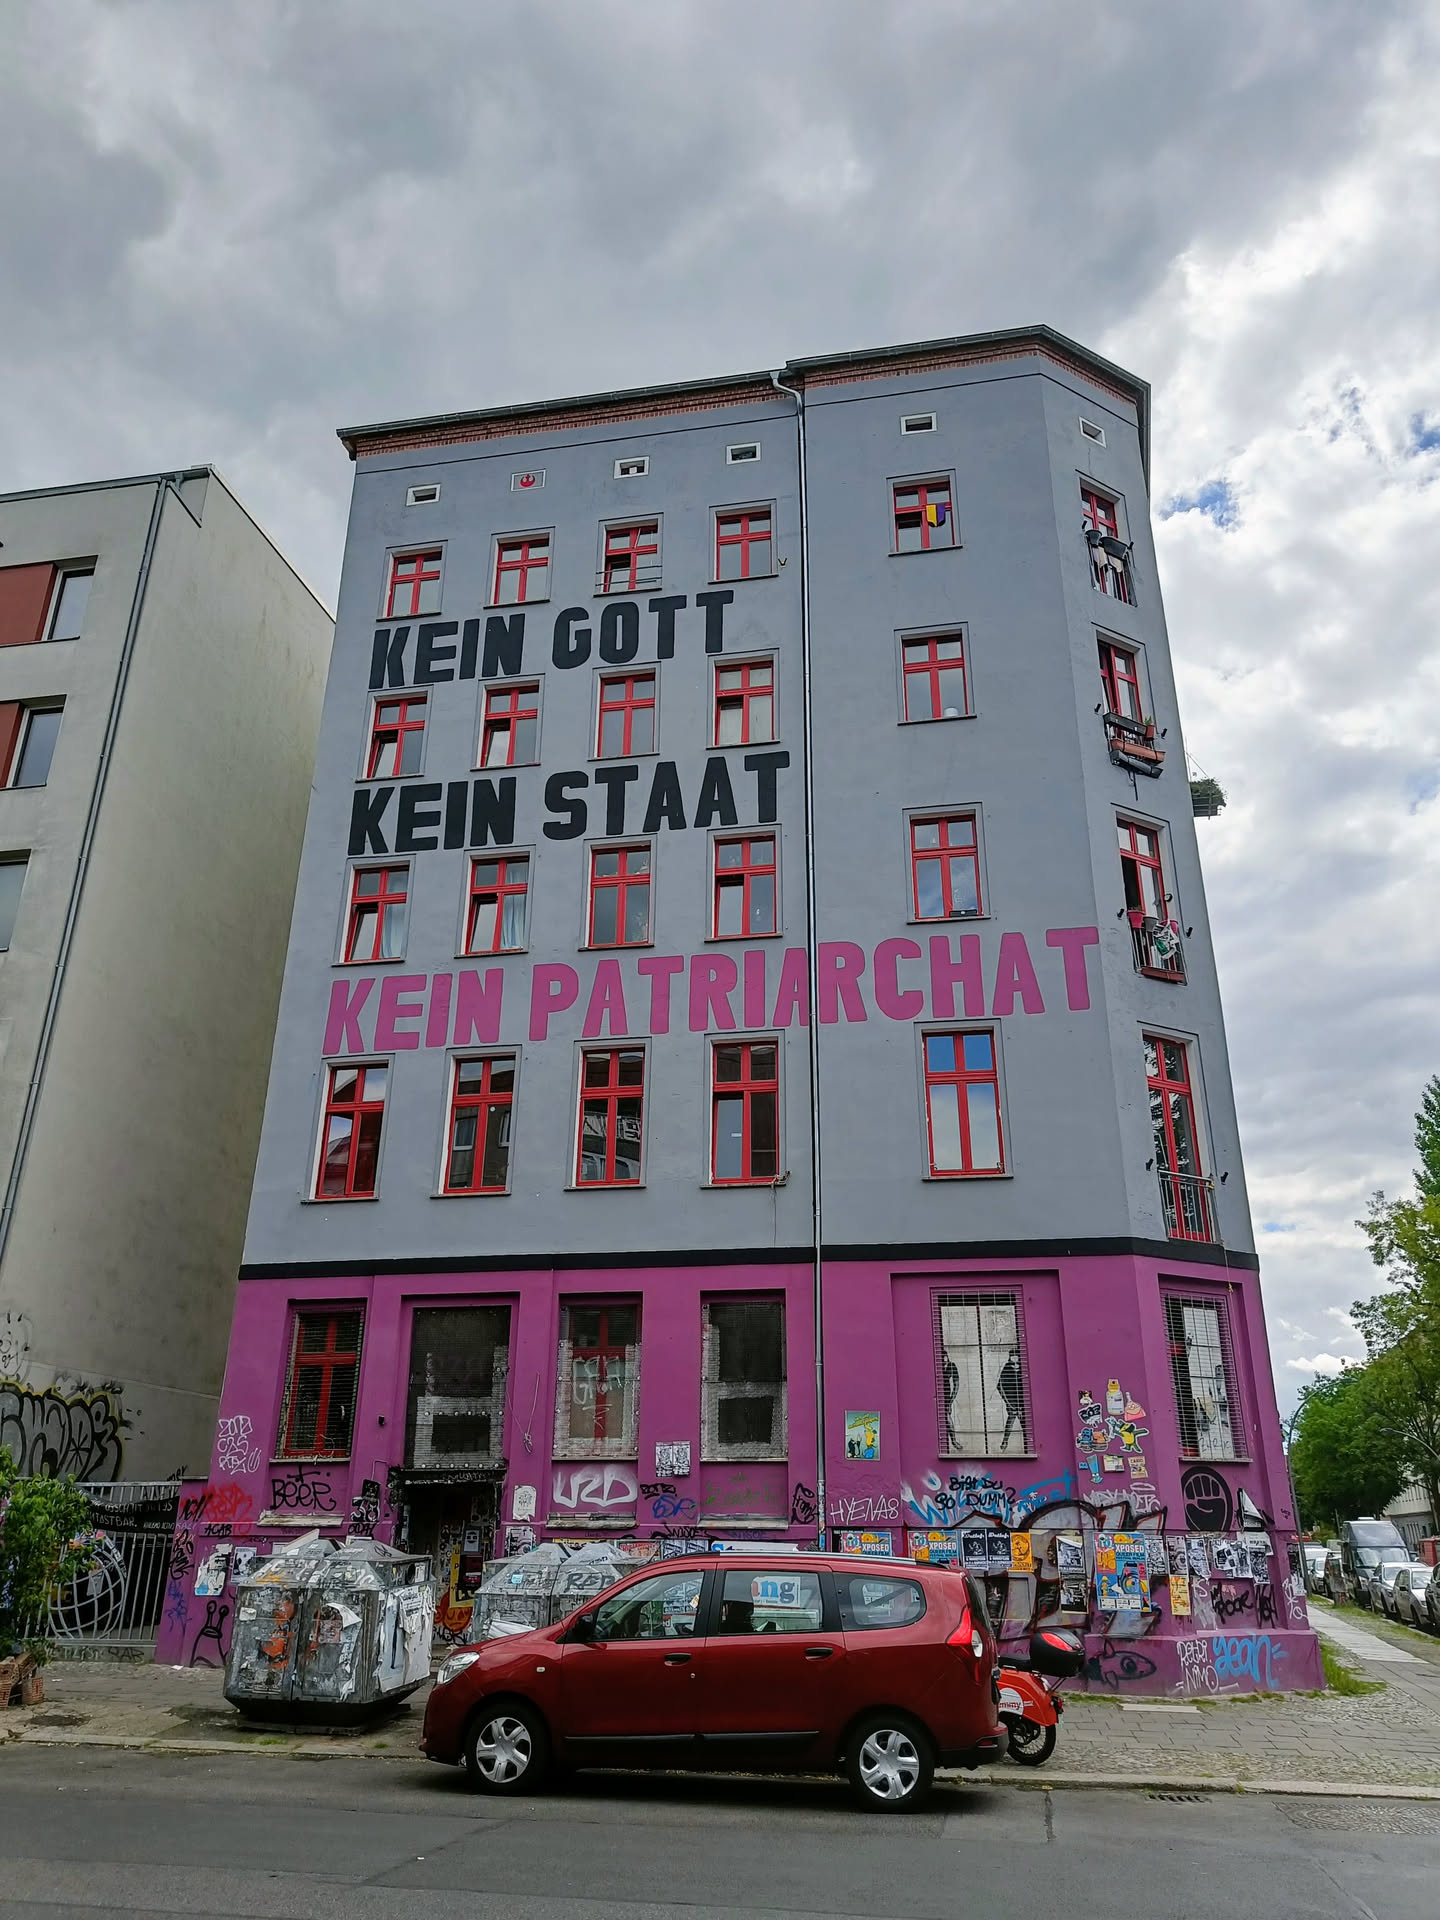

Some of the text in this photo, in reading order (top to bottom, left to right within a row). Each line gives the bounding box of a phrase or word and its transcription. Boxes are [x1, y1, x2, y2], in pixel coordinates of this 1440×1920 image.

[368, 589, 734, 690] KEIN GOTT
[347, 751, 790, 856] KEIN STAAT
[322, 926, 1100, 1055] KEIN PATRIARCHAT
[862, 1543, 889, 1552] XPOSED
[929, 1542, 957, 1551] XPOSED
[1115, 1544, 1145, 1553] XPOSED
[999, 1702, 1021, 1711] mmy
